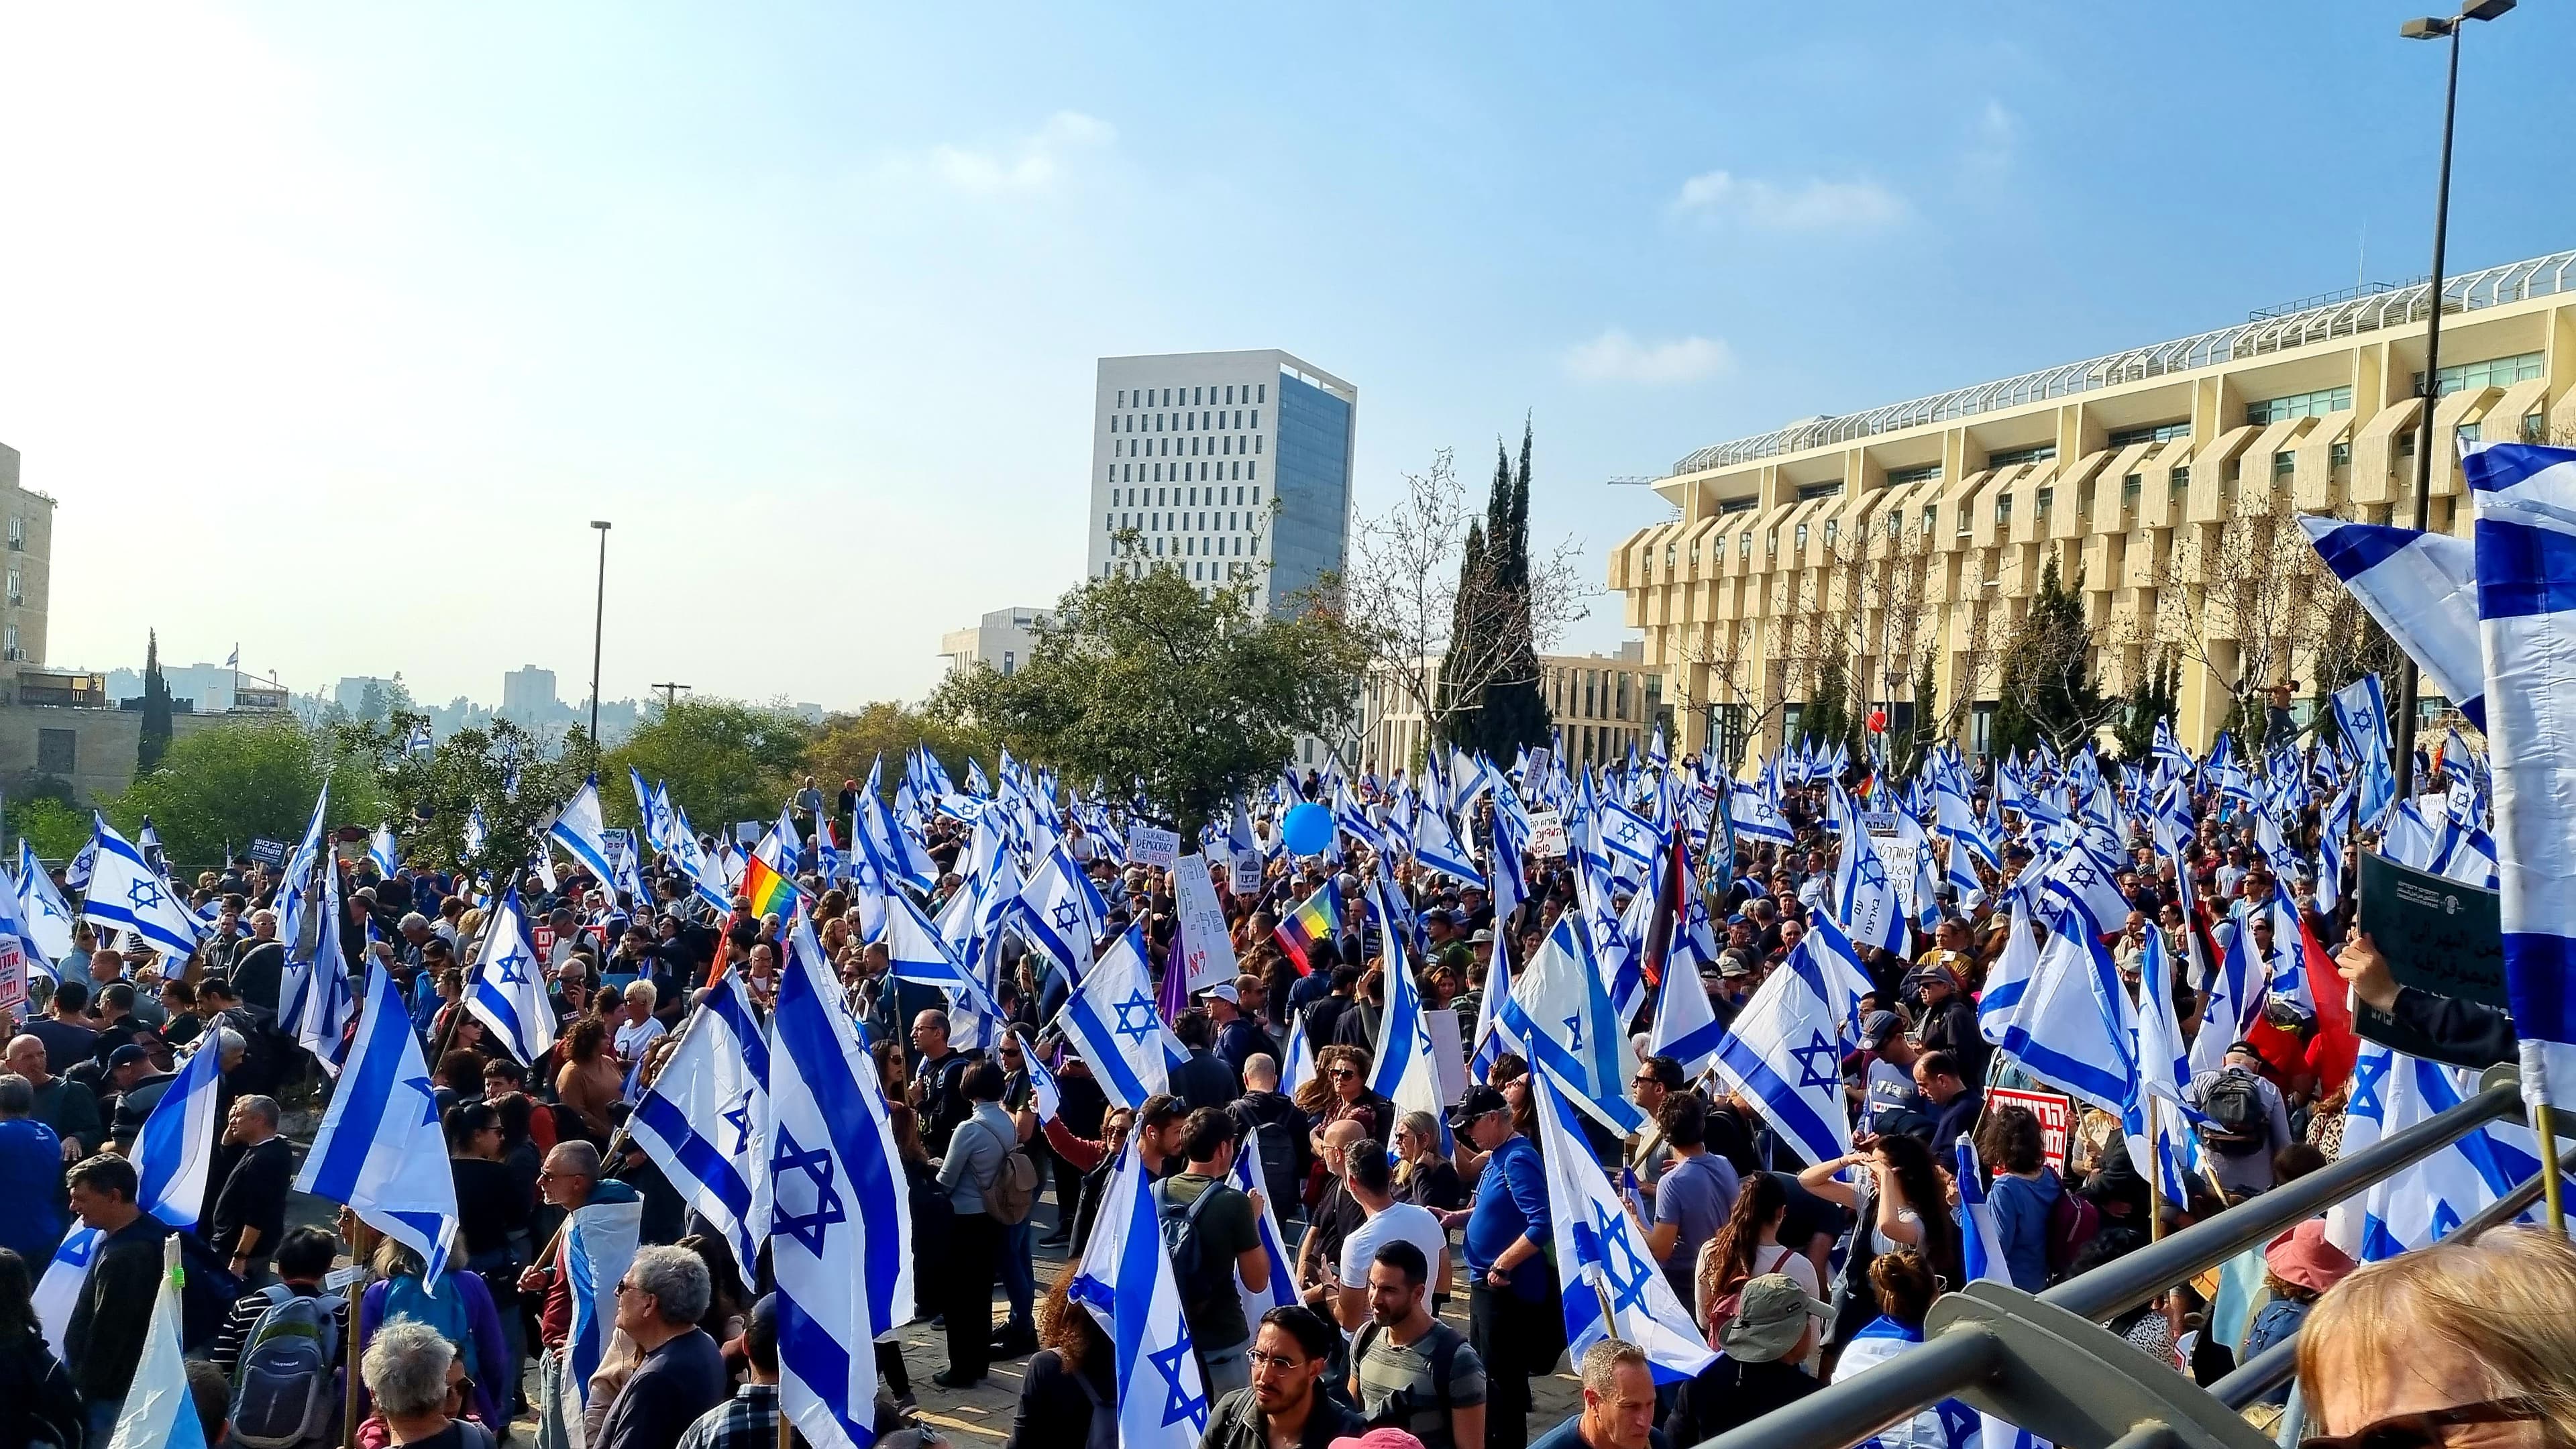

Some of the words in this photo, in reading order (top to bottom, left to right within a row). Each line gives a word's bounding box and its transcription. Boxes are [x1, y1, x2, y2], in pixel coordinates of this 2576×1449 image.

[1136, 839, 1173, 853] DEMOCRACY
[1135, 849, 1147, 859] WAS
[1854, 900, 1864, 916] עם
[1864, 898, 1880, 936] בארצנו
